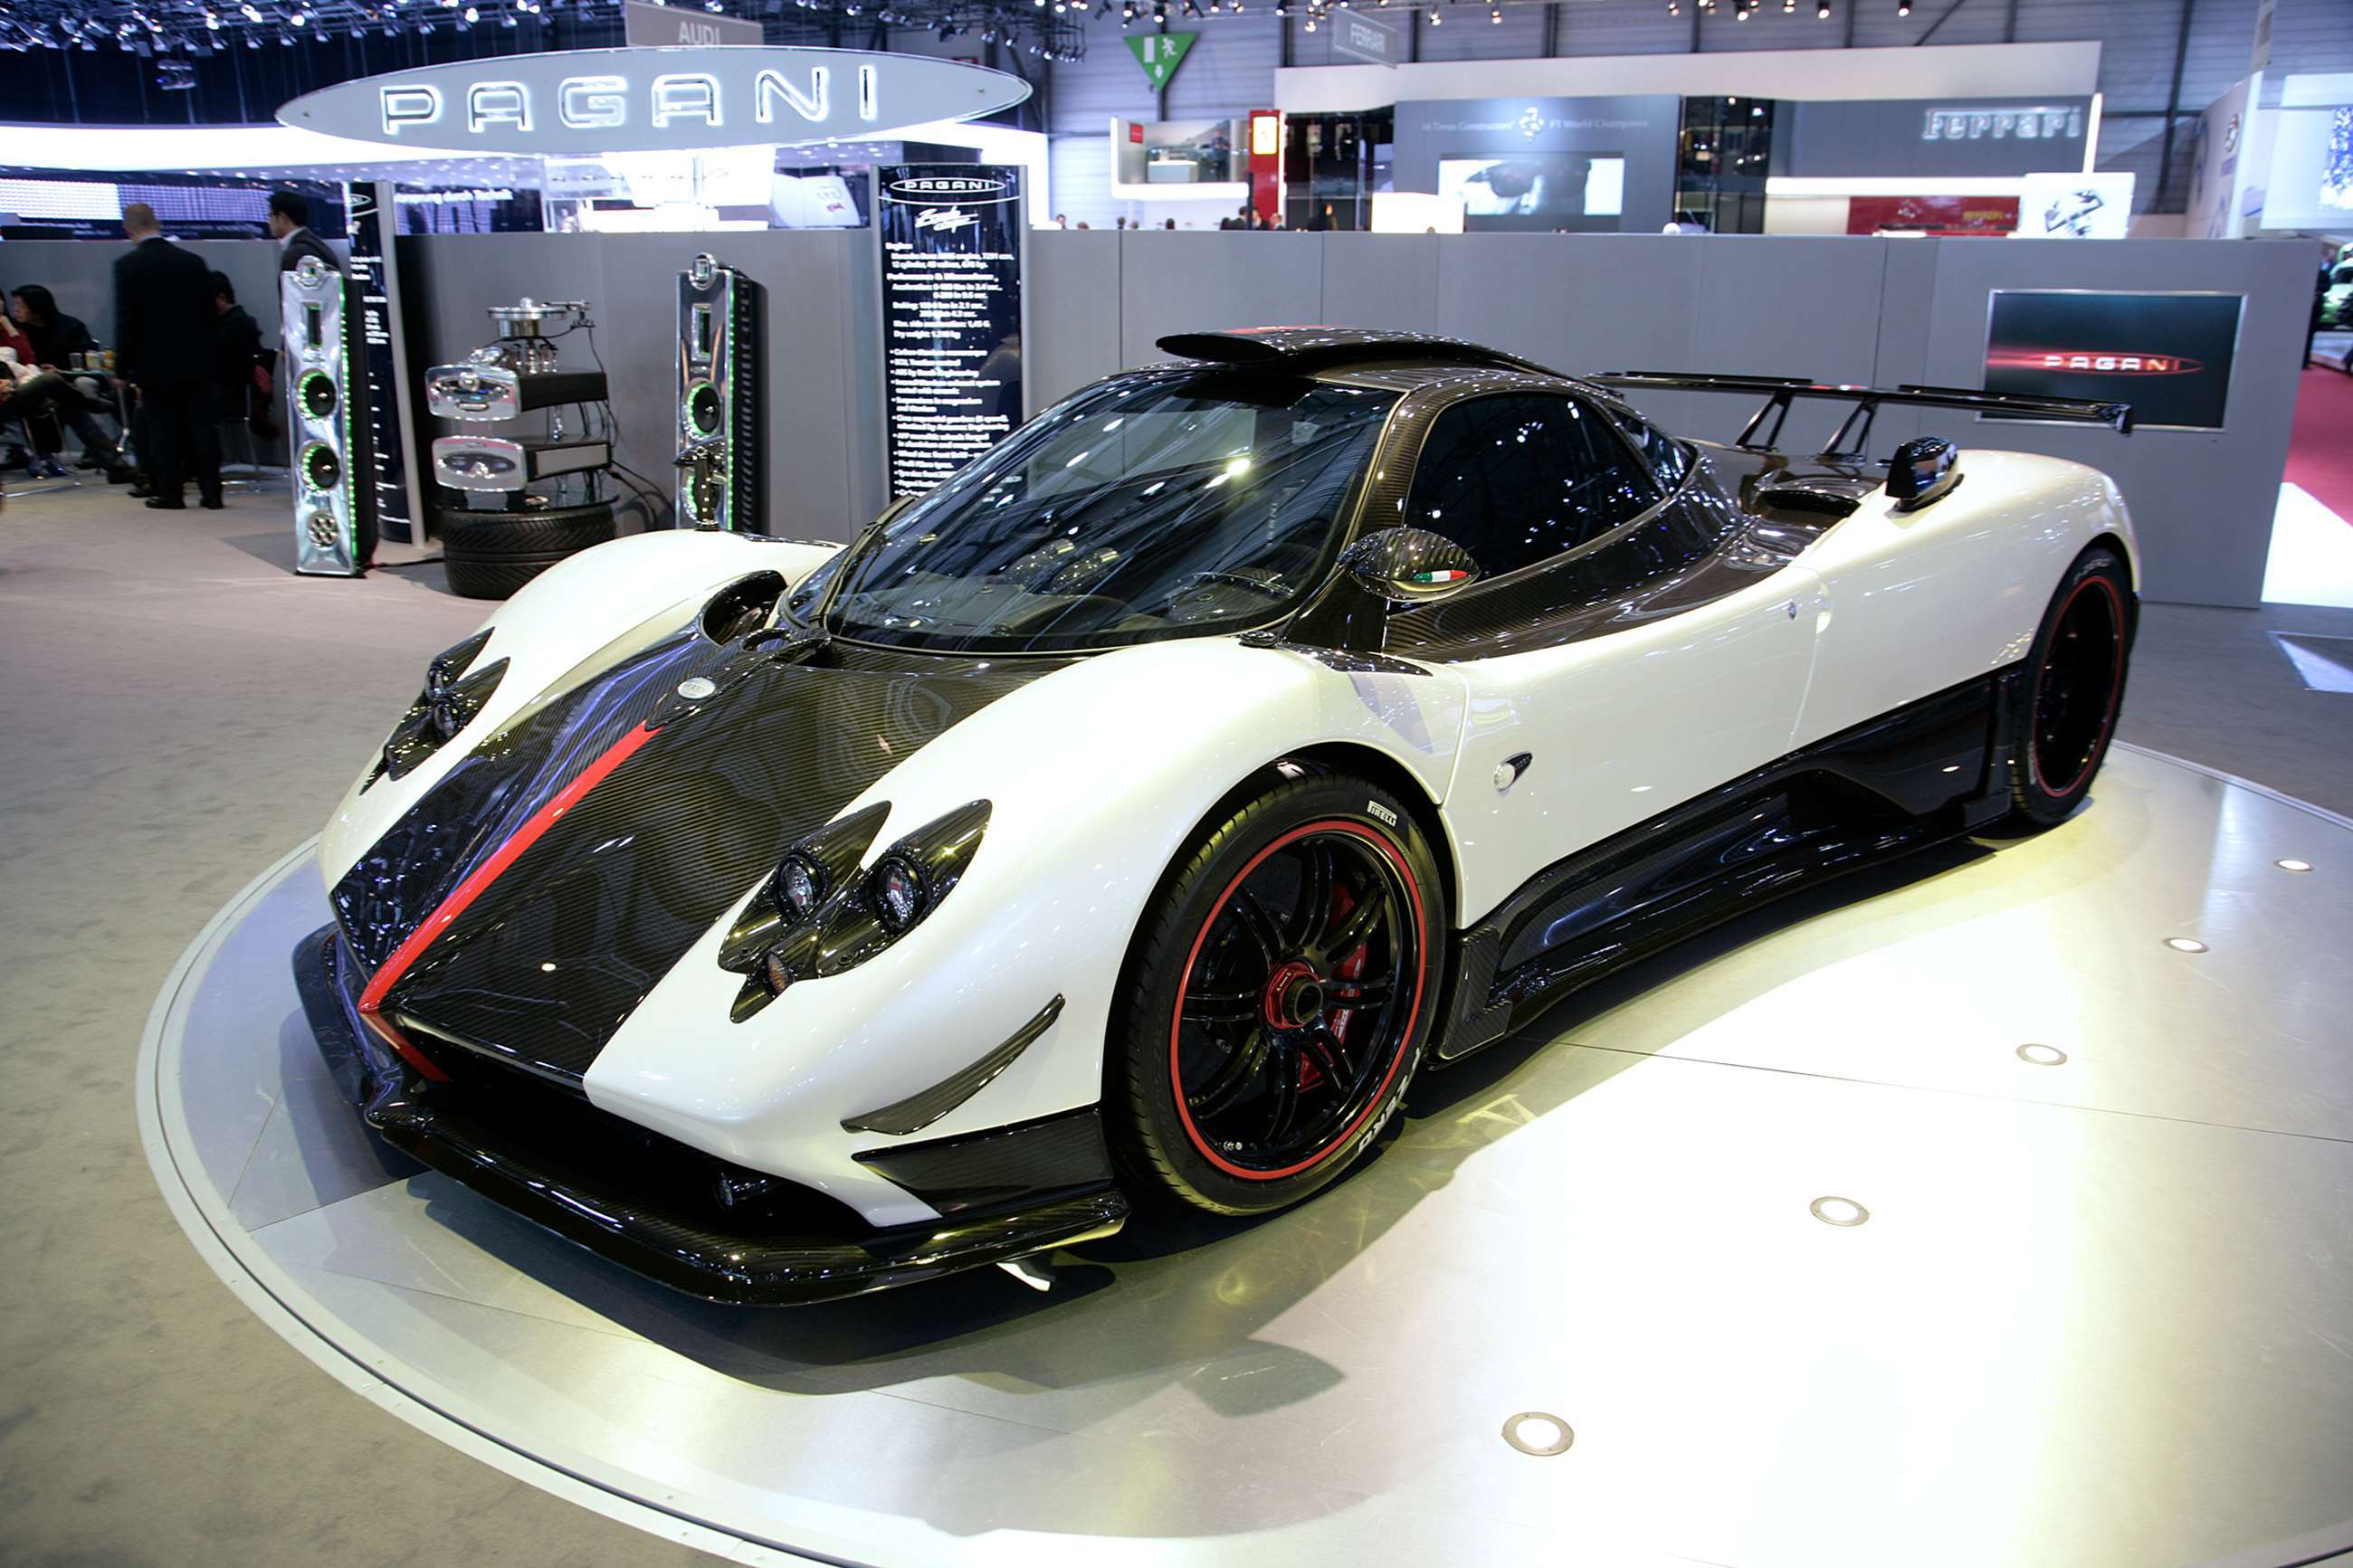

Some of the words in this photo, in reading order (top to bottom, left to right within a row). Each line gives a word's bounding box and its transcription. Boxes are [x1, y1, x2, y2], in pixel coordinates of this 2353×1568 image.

[679, 21, 720, 45] AUDI
[380, 64, 878, 135] PAGANI
[1922, 106, 2082, 139] Ferrari
[904, 181, 989, 190] PAGANI
[2044, 356, 2180, 371] PAGANI
[1367, 800, 1397, 827] PIRELLI
